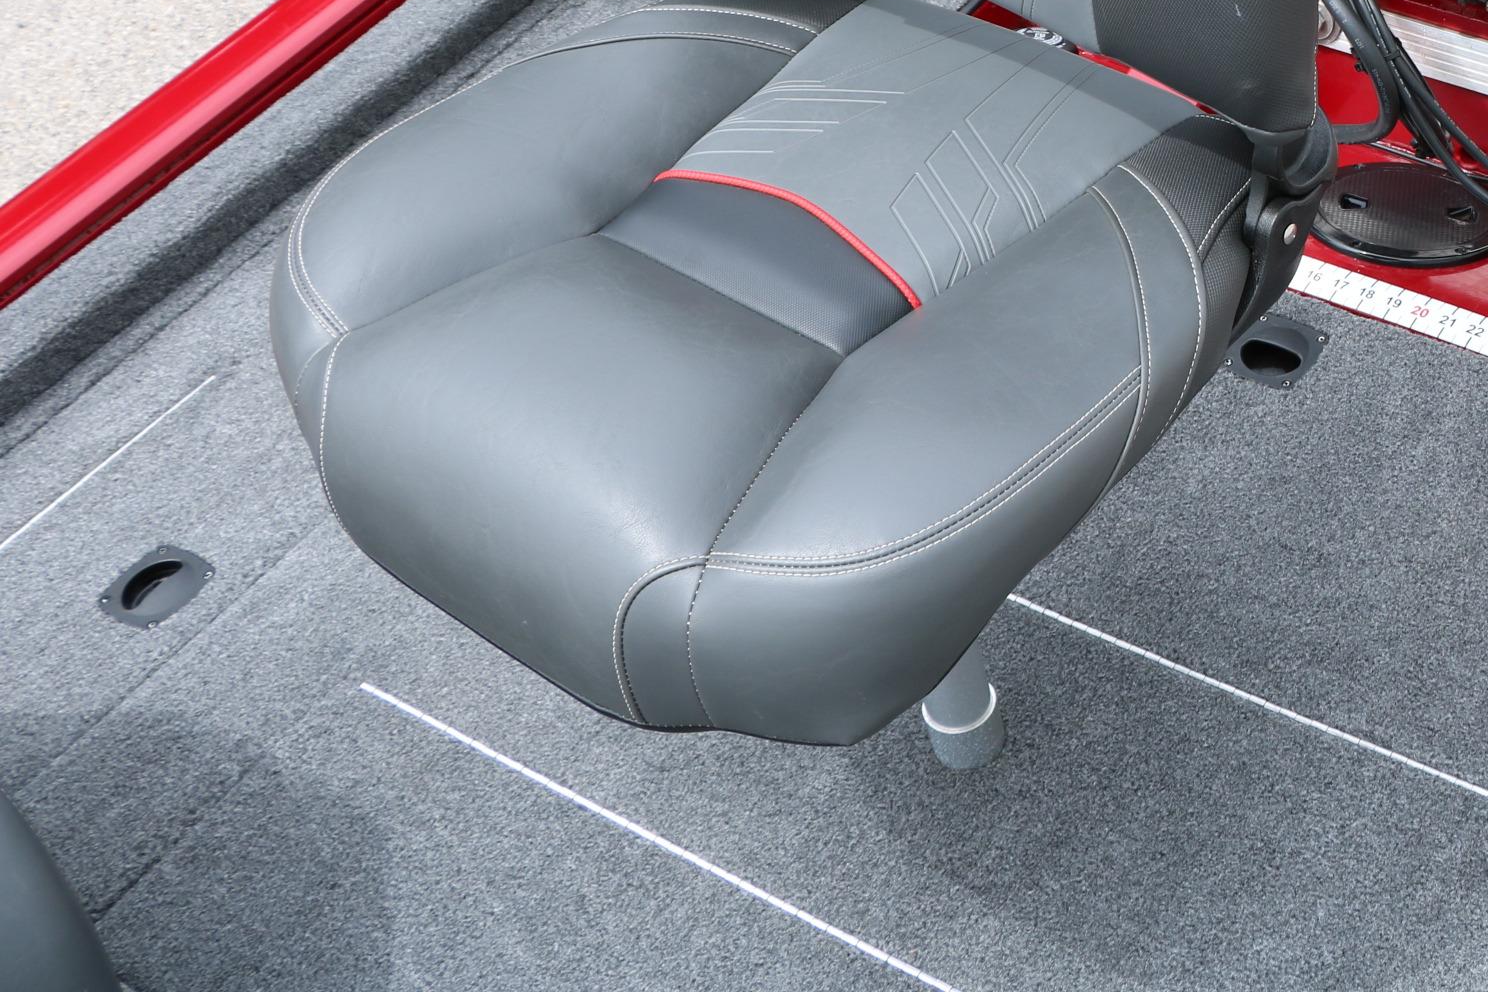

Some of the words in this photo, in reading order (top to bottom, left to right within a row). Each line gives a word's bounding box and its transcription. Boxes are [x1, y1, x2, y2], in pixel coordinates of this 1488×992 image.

[1308, 270, 1321, 282] 16
[1334, 278, 1349, 290] 17
[1360, 288, 1375, 299] 18
[1387, 297, 1402, 308] 19
[1411, 306, 1429, 318] 20
[1438, 316, 1456, 327] 21
[1466, 325, 1485, 337] 22
